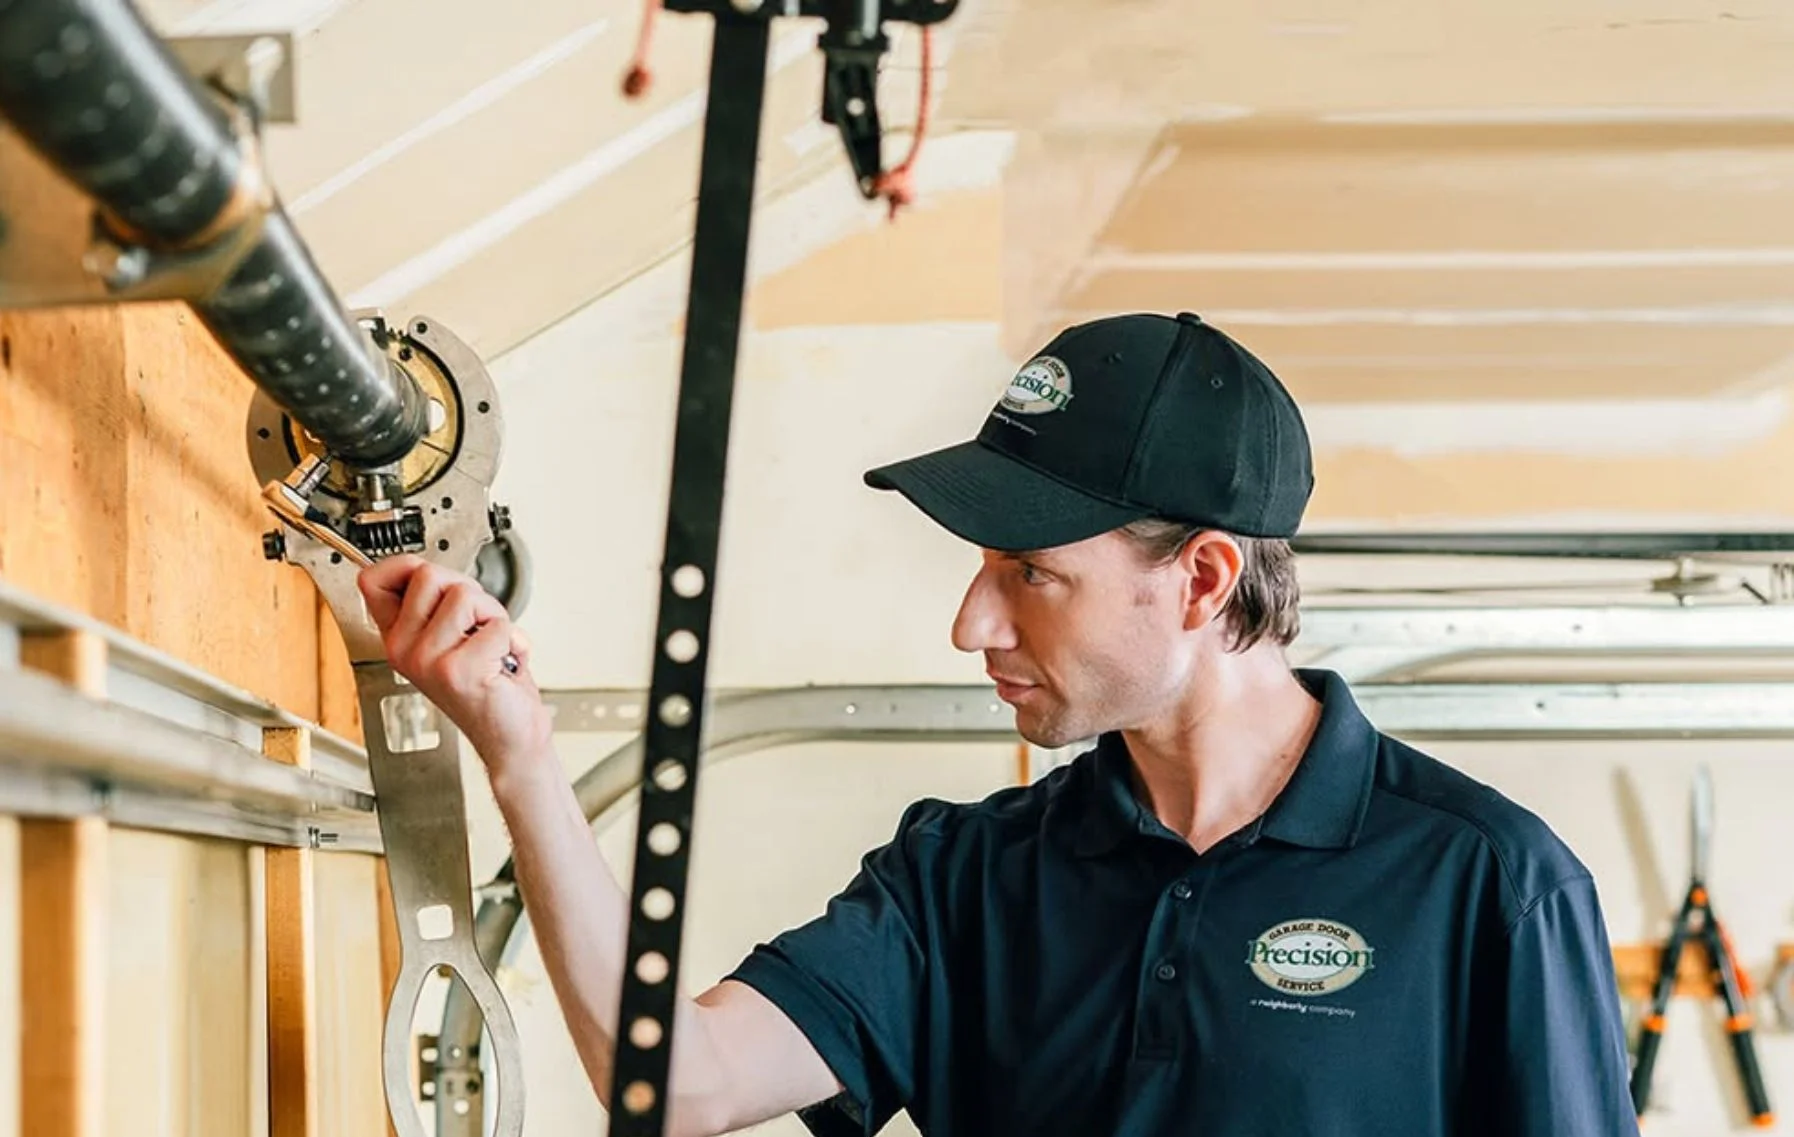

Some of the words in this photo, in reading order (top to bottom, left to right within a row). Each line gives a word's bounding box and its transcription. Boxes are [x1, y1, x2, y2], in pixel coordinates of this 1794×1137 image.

[1269, 922, 1314, 940] GARAGE
[1317, 923, 1351, 941] DOOR
[1245, 940, 1375, 969] Precision
[1277, 978, 1325, 991] SERVICE
[1308, 1004, 1356, 1017] company
